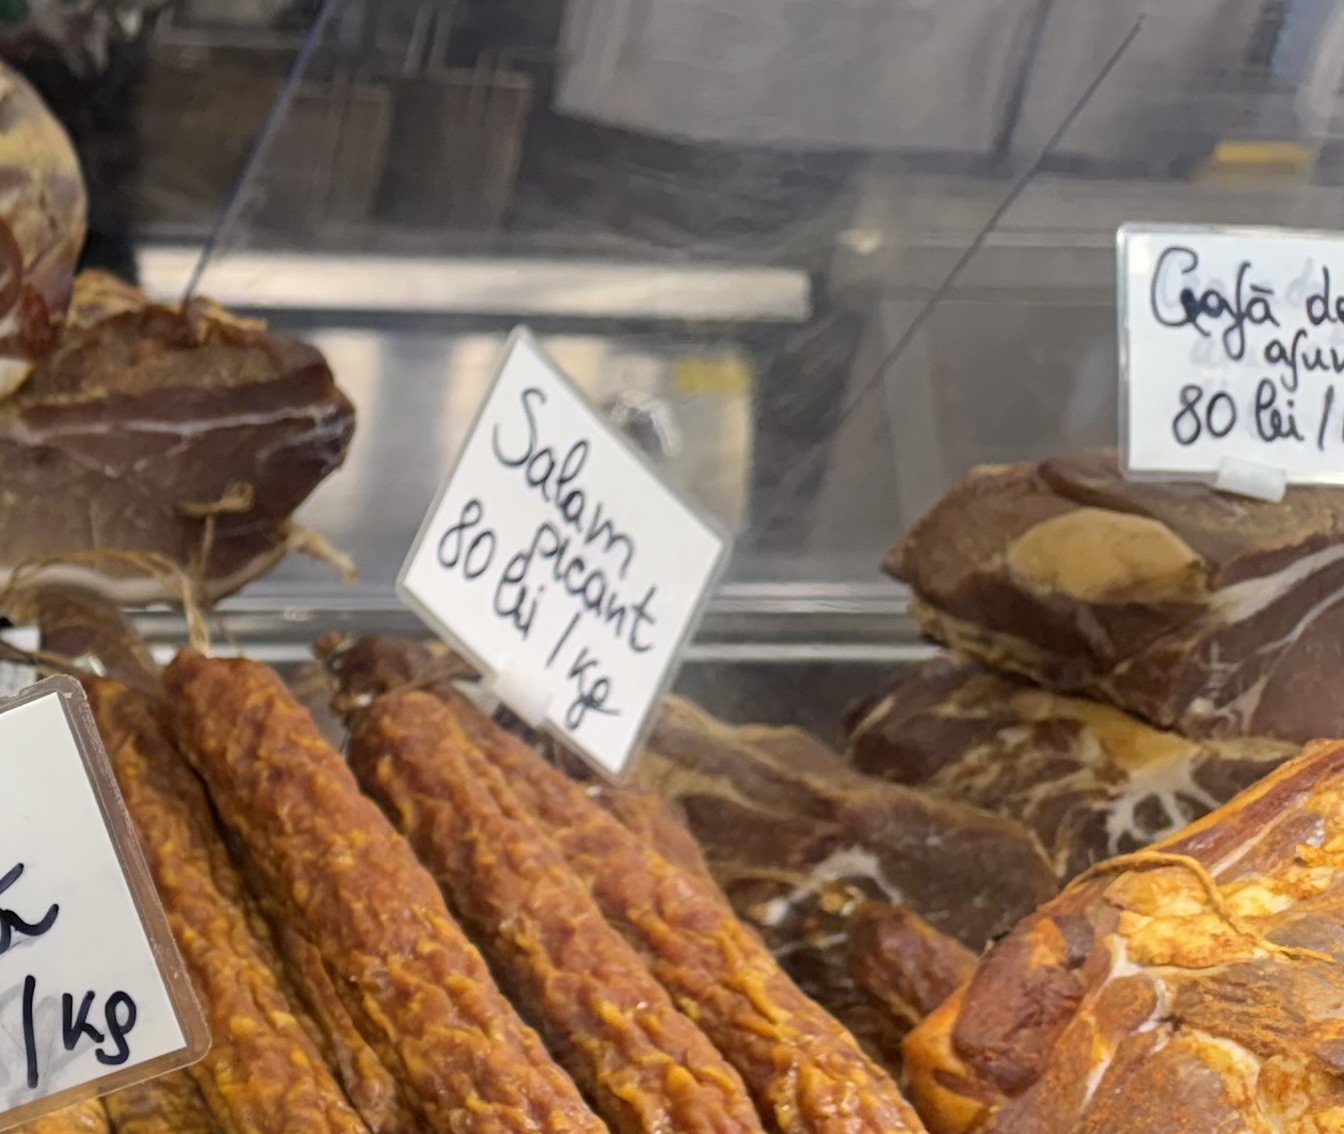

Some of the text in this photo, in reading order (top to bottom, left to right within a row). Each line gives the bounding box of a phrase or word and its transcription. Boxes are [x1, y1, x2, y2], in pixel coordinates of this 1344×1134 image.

[1172, 385, 1237, 447] 80
[1254, 378, 1305, 443] lei
[492, 387, 634, 577] Salam
[436, 499, 496, 581] 80
[493, 550, 547, 642] lei
[525, 521, 657, 653] picant
